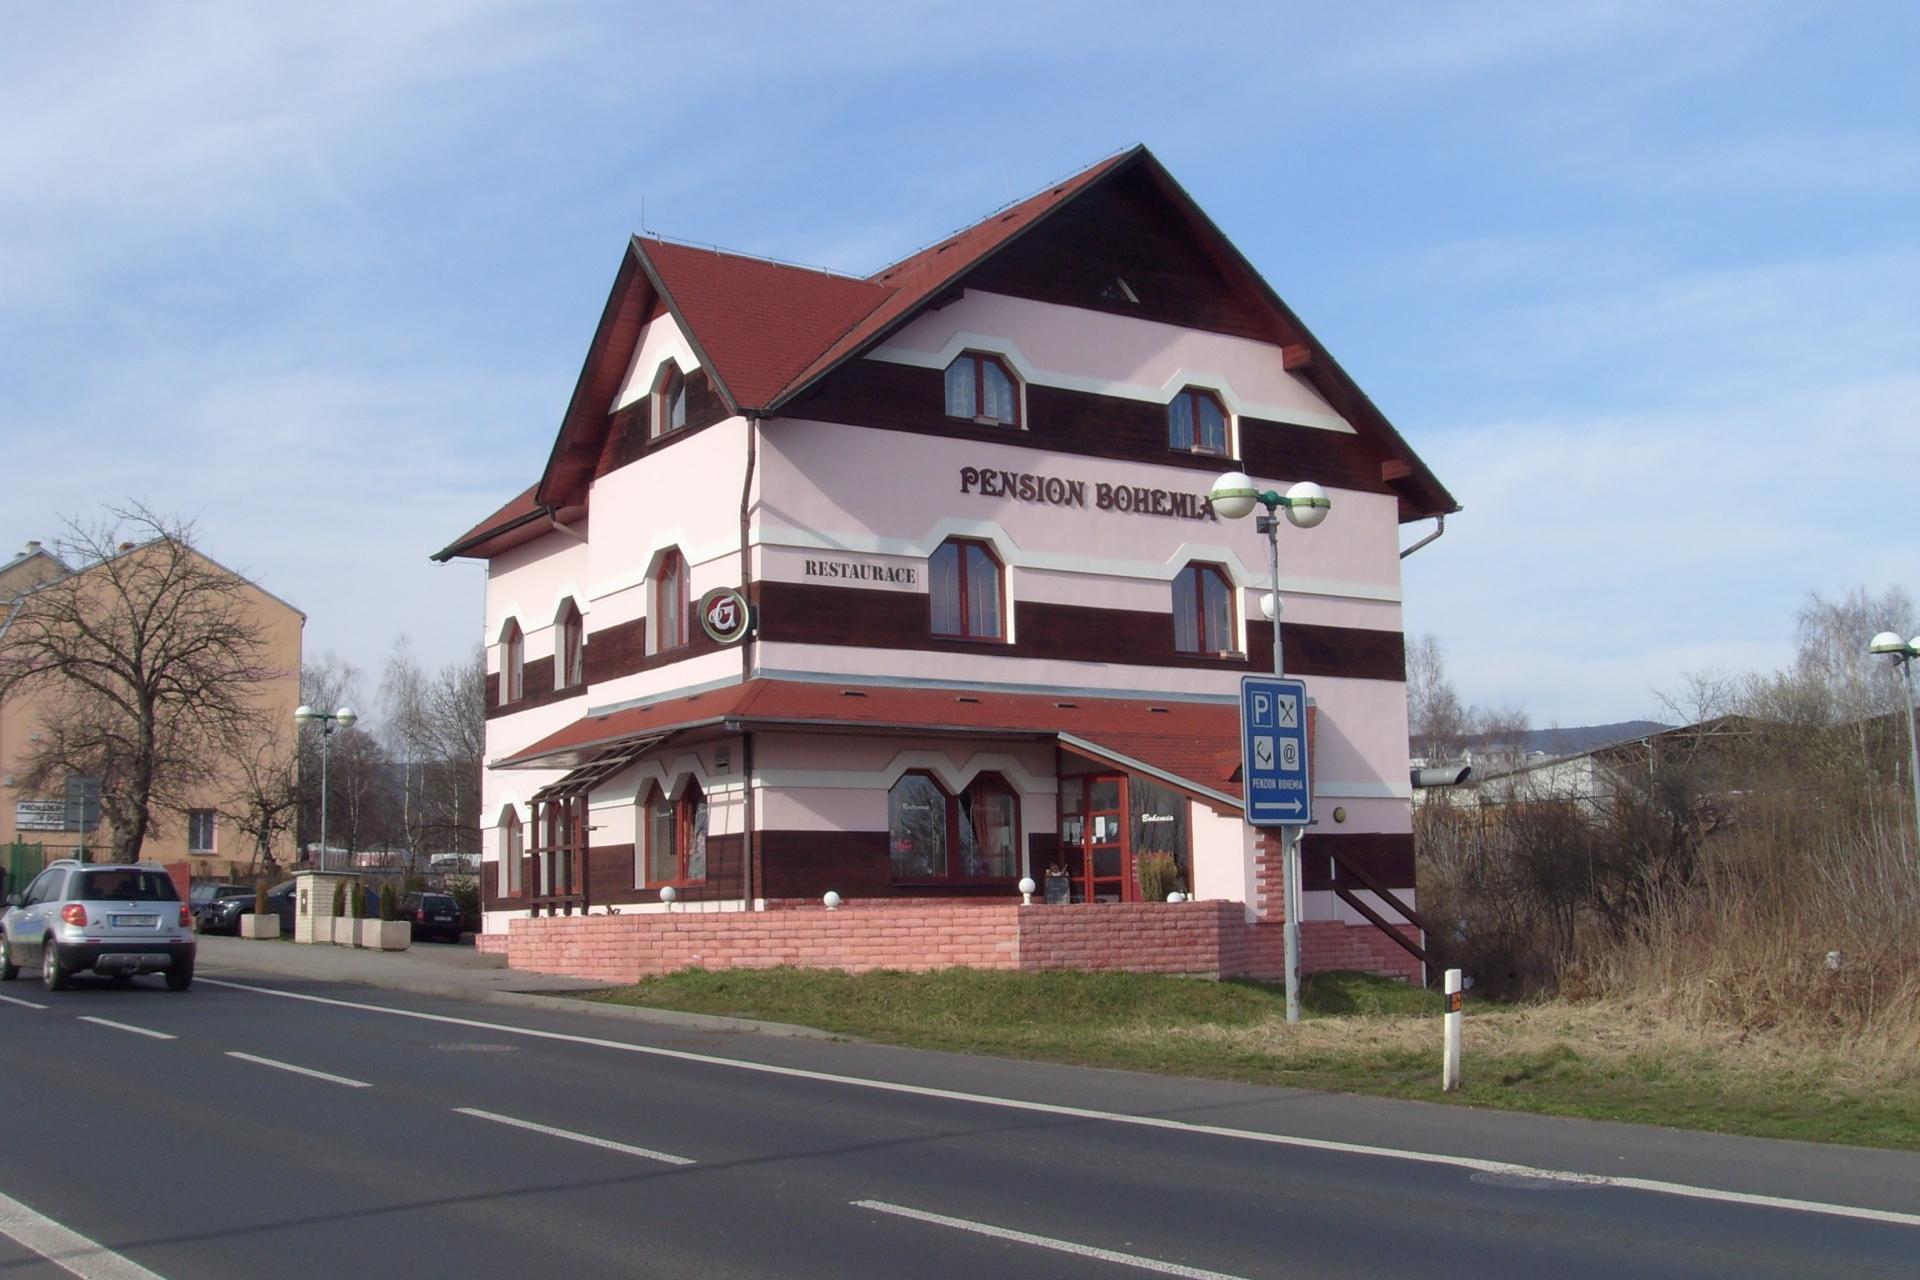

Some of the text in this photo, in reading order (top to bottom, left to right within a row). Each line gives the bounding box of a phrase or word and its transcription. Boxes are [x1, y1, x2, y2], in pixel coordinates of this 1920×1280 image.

[960, 466, 1218, 521] PENSION BOHEMIA
[805, 559, 916, 584] RESTAURACE
[1254, 694, 1269, 723] P
